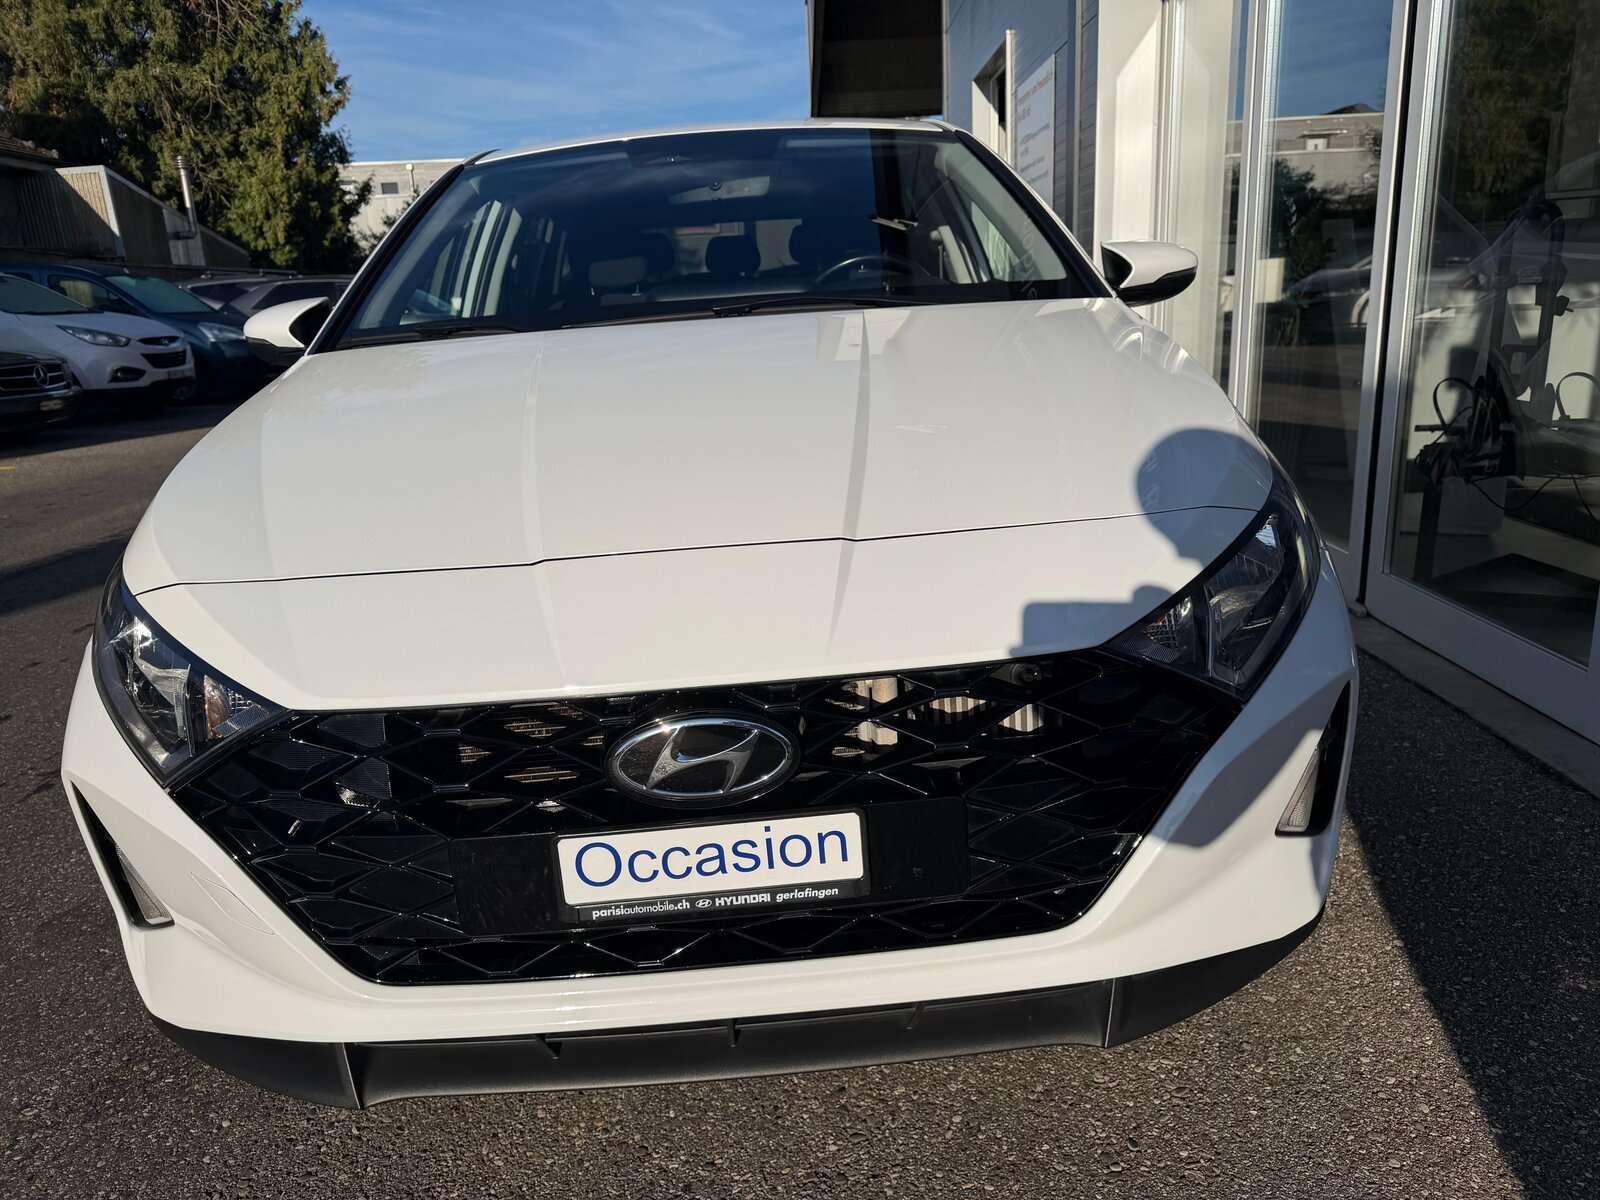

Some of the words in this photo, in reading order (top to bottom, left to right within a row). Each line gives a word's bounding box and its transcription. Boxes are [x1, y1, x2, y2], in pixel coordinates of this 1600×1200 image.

[575, 825, 849, 887] Occasion
[592, 900, 690, 920] parisiautomobile.ch
[715, 892, 771, 907] HYUNDAI
[776, 887, 839, 903] gerlafingen
